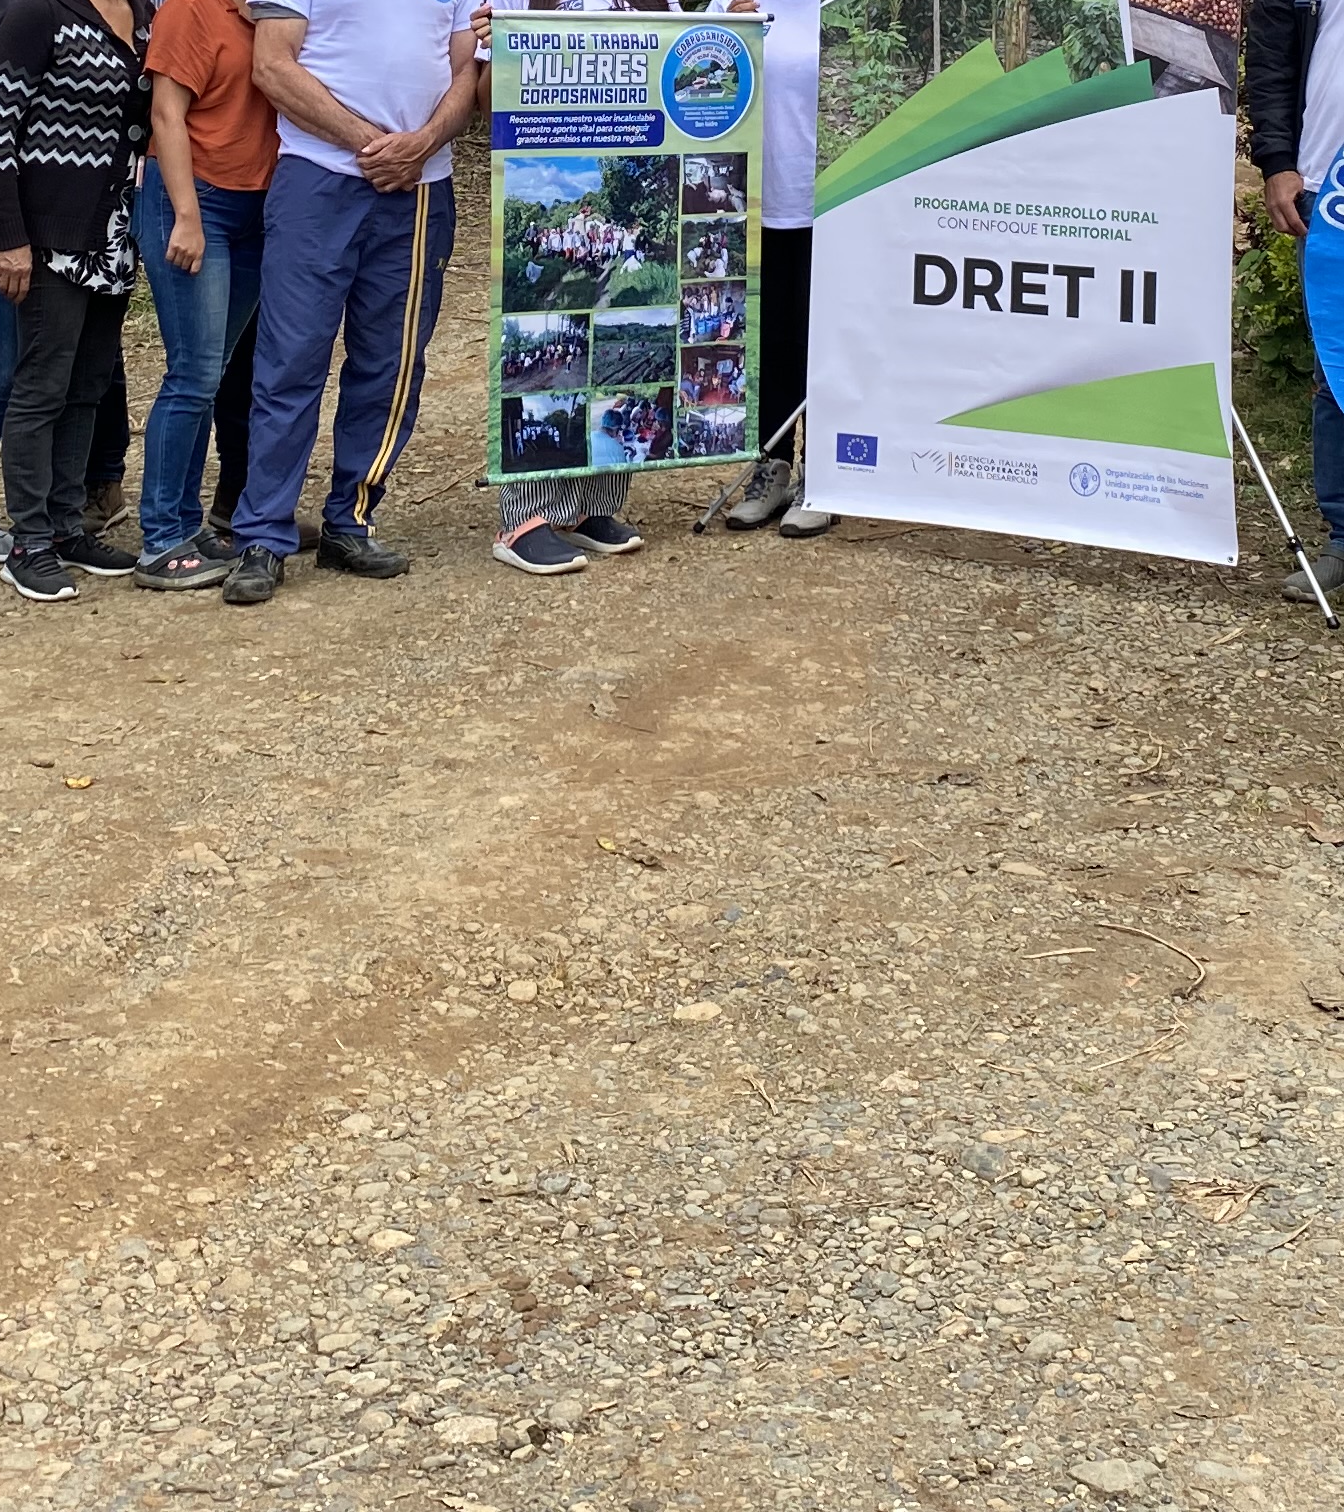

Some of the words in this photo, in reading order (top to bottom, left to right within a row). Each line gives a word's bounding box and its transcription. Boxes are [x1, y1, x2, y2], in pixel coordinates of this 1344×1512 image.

[508, 34, 561, 50] GRUPO
[567, 34, 585, 50] DE
[591, 33, 659, 50] TRABAJO
[676, 31, 741, 57] CORPOSANISIDRO
[521, 53, 648, 85] MUJERES
[520, 88, 647, 104] CORPOSANISIDRO
[509, 115, 562, 124] Reconocemos
[563, 115, 593, 123] nuestro
[594, 114, 613, 123] valor
[613, 113, 656, 122] incalculable
[521, 126, 551, 134] nuestro
[552, 125, 577, 135] aporte
[578, 123, 595, 133] vital
[596, 125, 613, 135] para
[614, 123, 650, 134] conseguir
[516, 134, 548, 146] grandes
[549, 134, 581, 144] cambios
[581, 135, 592, 143] en
[593, 134, 622, 143] nuestra
[914, 196, 990, 214] PROGRAMA
[993, 202, 1012, 215] DE
[1016, 203, 1107, 221] DESARROLLO
[1111, 209, 1159, 225] RURAL
[937, 216, 969, 230] CON
[972, 218, 1039, 236] ENFOQUE
[1042, 223, 1133, 242] TERRITORIAL
[912, 253, 1096, 319] DRET
[1119, 269, 1158, 325] II
[954, 454, 996, 465] AGENCIA
[999, 459, 1038, 470] ITALIANA
[969, 463, 1038, 477] COOPERACIÓN
[954, 469, 975, 477] PARA
[976, 471, 985, 479] EL
[986, 473, 1038, 485] DESARROLLO
[1106, 468, 1155, 481] Organización
[1156, 473, 1166, 482] de
[1166, 473, 1177, 484] las
[1178, 477, 1209, 489] Naciones
[1106, 479, 1131, 490] Unidas
[1132, 483, 1149, 493] para
[1151, 483, 1158, 493] la
[1159, 485, 1205, 499] Alimentación
[1111, 490, 1118, 499] la
[1119, 491, 1161, 504] Agricultura
